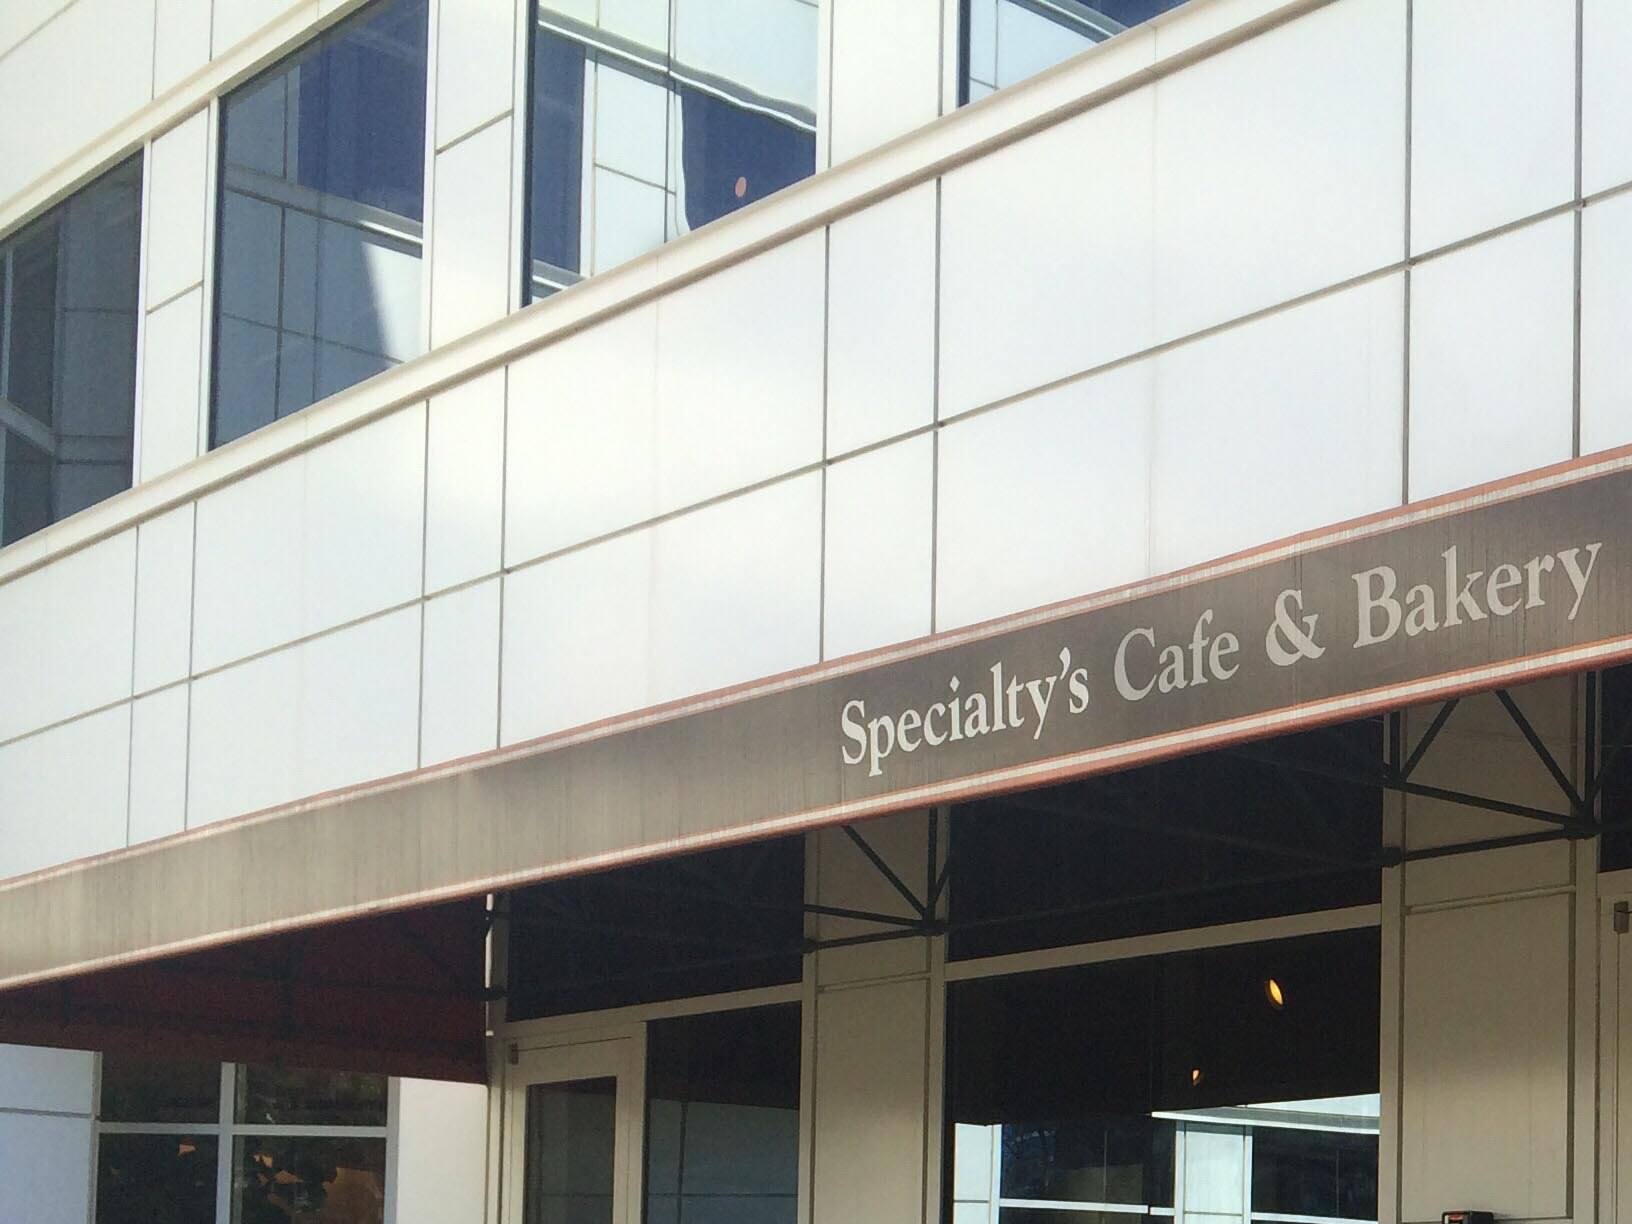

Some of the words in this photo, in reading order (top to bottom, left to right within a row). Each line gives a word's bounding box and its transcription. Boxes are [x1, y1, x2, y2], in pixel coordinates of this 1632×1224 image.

[841, 646, 1090, 777] Specialty's
[1113, 608, 1240, 702] Cafe
[1264, 588, 1326, 667] &
[1351, 542, 1602, 649] Bakery
